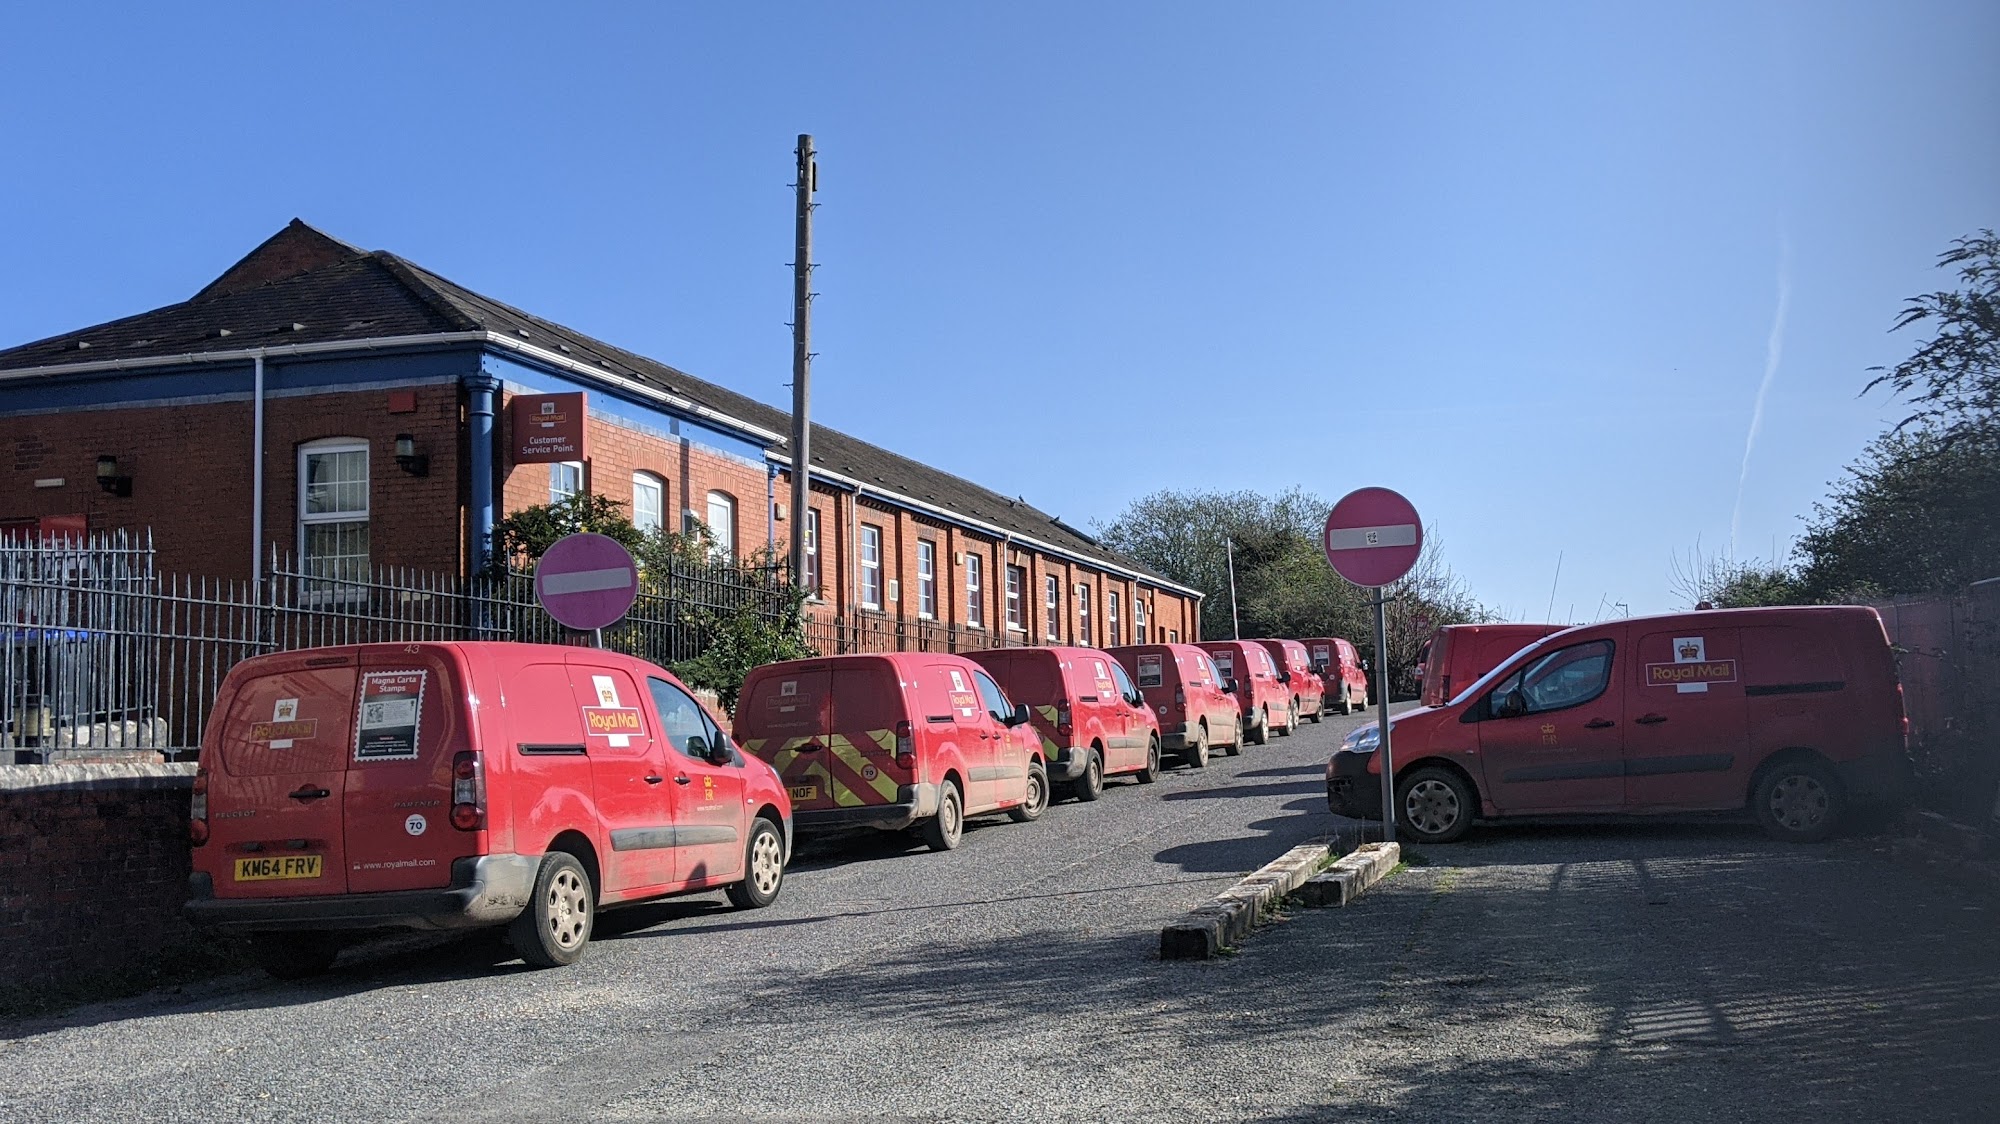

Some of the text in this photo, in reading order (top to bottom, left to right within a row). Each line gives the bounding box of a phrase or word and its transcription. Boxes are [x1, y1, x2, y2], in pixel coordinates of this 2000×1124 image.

[529, 436, 566, 444] Customer
[522, 444, 574, 455] Service Point
[404, 644, 420, 654] 43
[1652, 663, 1730, 681] Royal Mail
[371, 676, 417, 686] Magna Carta
[379, 685, 406, 693] Stamps
[588, 711, 639, 732] Royal Mail
[254, 724, 286, 738] Royal
[393, 800, 440, 808] PARTNER
[215, 810, 256, 819] PEUGEOT
[409, 821, 423, 831] 70
[242, 858, 316, 877] KM64 FRV
[363, 858, 436, 870] www.royalmail.com
